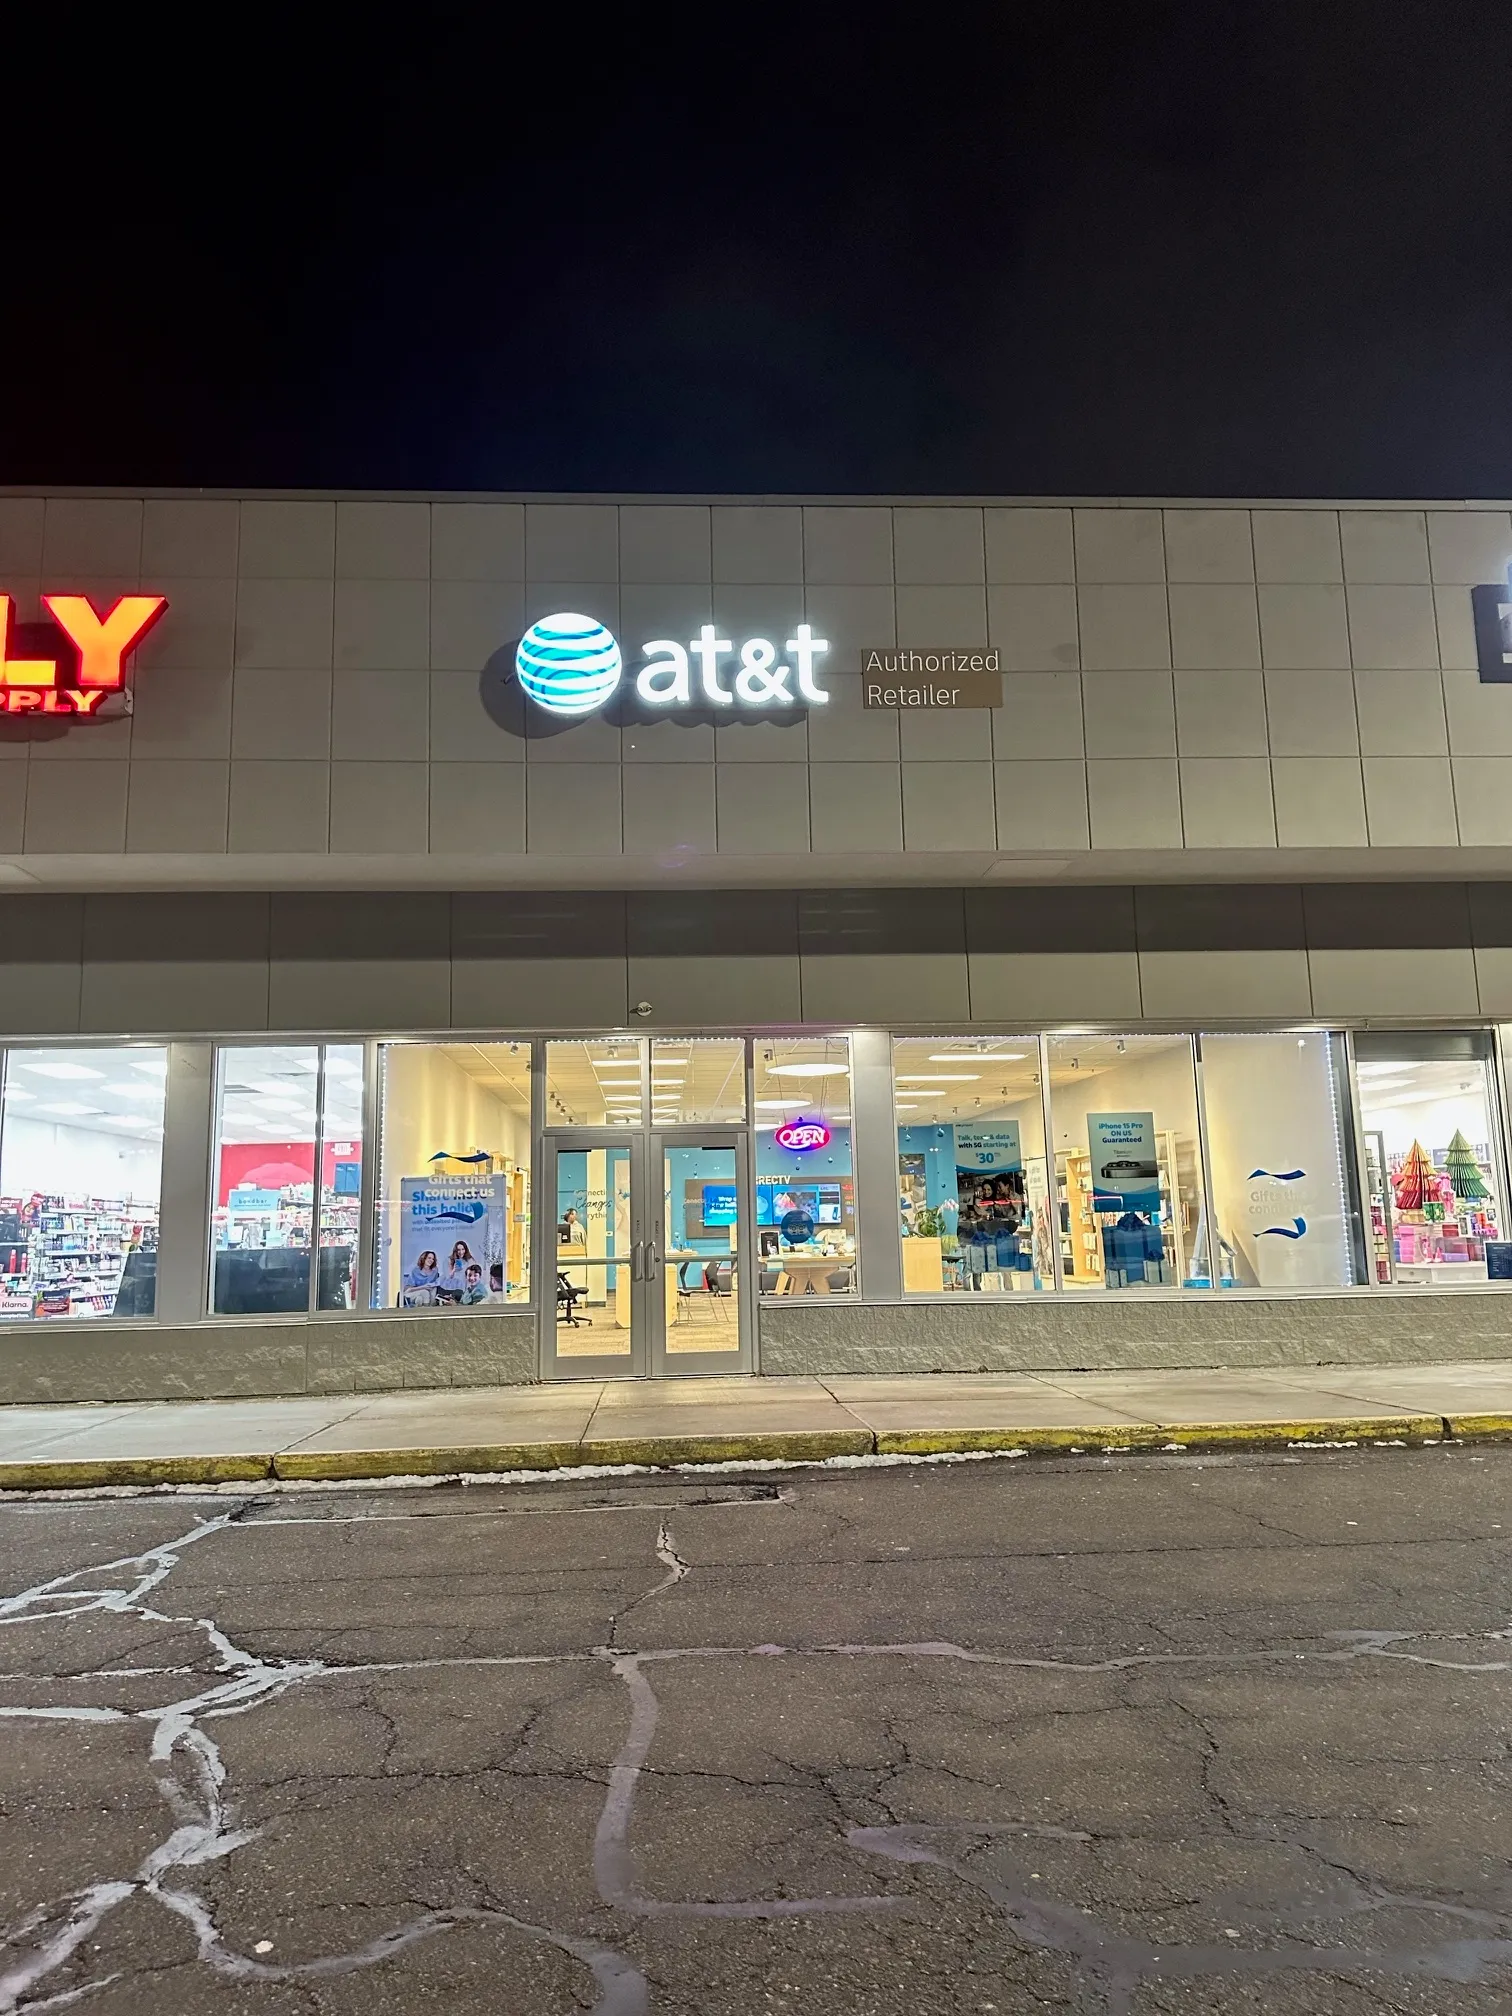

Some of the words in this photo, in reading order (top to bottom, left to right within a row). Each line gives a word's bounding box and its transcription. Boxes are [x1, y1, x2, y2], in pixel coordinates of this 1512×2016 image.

[636, 624, 829, 703] at&t
[866, 650, 999, 672] Authorized
[0, 690, 104, 712] PLY
[868, 684, 960, 706] Retailer
[779, 1125, 826, 1149] OPEN
[957, 1134, 972, 1142] Talk,
[975, 1152, 995, 1164] $30
[428, 1175, 462, 1185] Gifts
[463, 1174, 493, 1185] that
[424, 1187, 479, 1198] connect
[480, 1188, 495, 1197] us
[1250, 1191, 1281, 1202] Gifts
[412, 1203, 438, 1216] this
